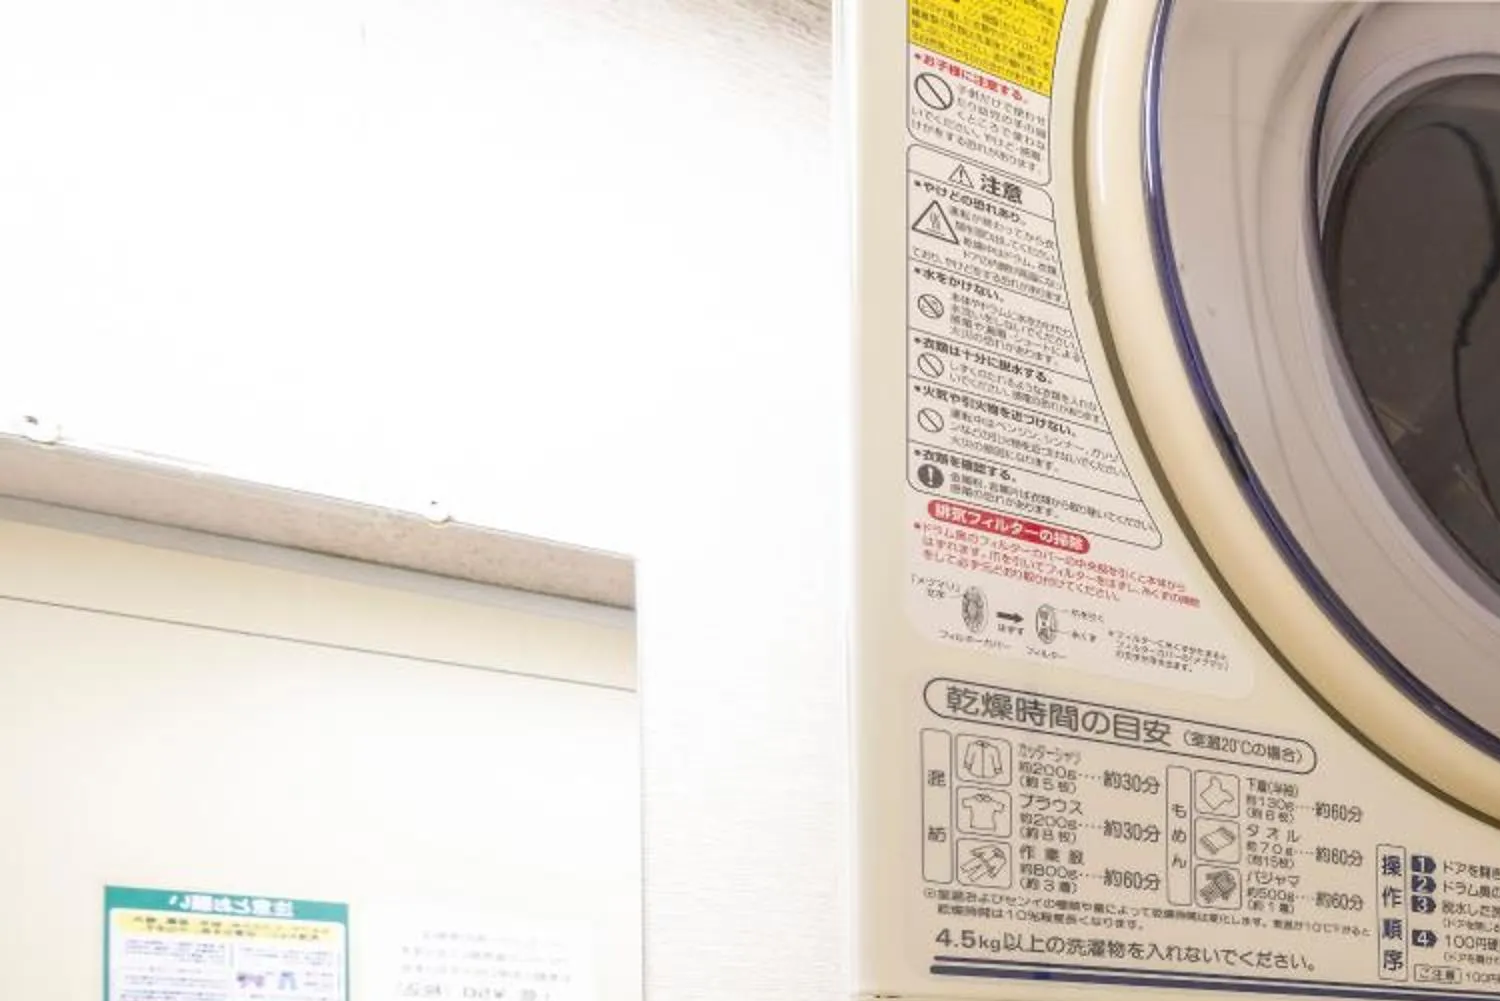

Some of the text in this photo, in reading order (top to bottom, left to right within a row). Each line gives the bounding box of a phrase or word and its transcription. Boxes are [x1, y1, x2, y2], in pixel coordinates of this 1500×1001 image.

[981, 173, 1022, 204] 注意
[946, 685, 1172, 748] 乾燥時間の目安
[1103, 770, 1160, 795] 約30分
[1021, 794, 1083, 815] ブラウス
[1103, 819, 1160, 843] 約30分
[1171, 803, 1187, 869] もめん
[1103, 868, 1161, 891] 約60分
[1247, 870, 1300, 888] パジャマ
[1382, 855, 1403, 972] 操作順序
[935, 927, 1317, 974] 4.5kg以上の洗濯物を入れないでください。
